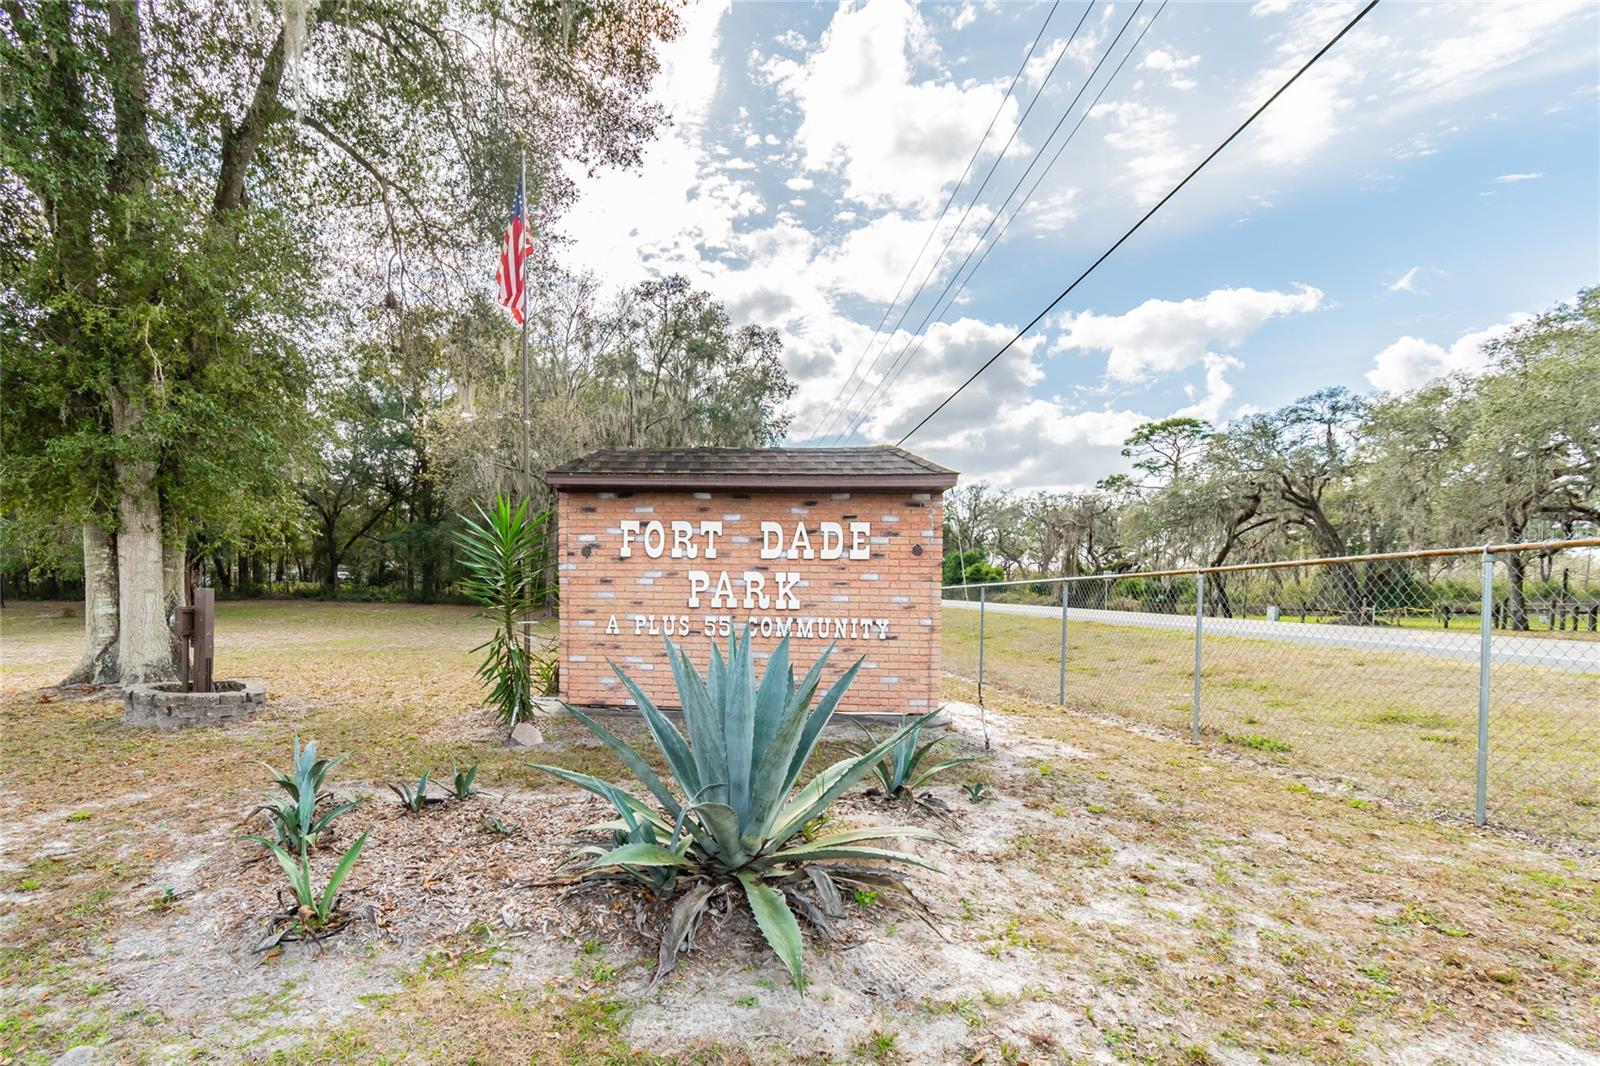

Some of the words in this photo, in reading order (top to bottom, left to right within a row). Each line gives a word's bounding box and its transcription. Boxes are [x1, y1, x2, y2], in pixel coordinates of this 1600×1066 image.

[620, 520, 722, 558] FORT
[760, 521, 871, 560] DADE
[688, 570, 800, 610] PARK
[605, 614, 620, 634] A
[634, 614, 690, 636] PLUS
[704, 615, 731, 637] 55
[748, 616, 889, 640] COMMUNITY
